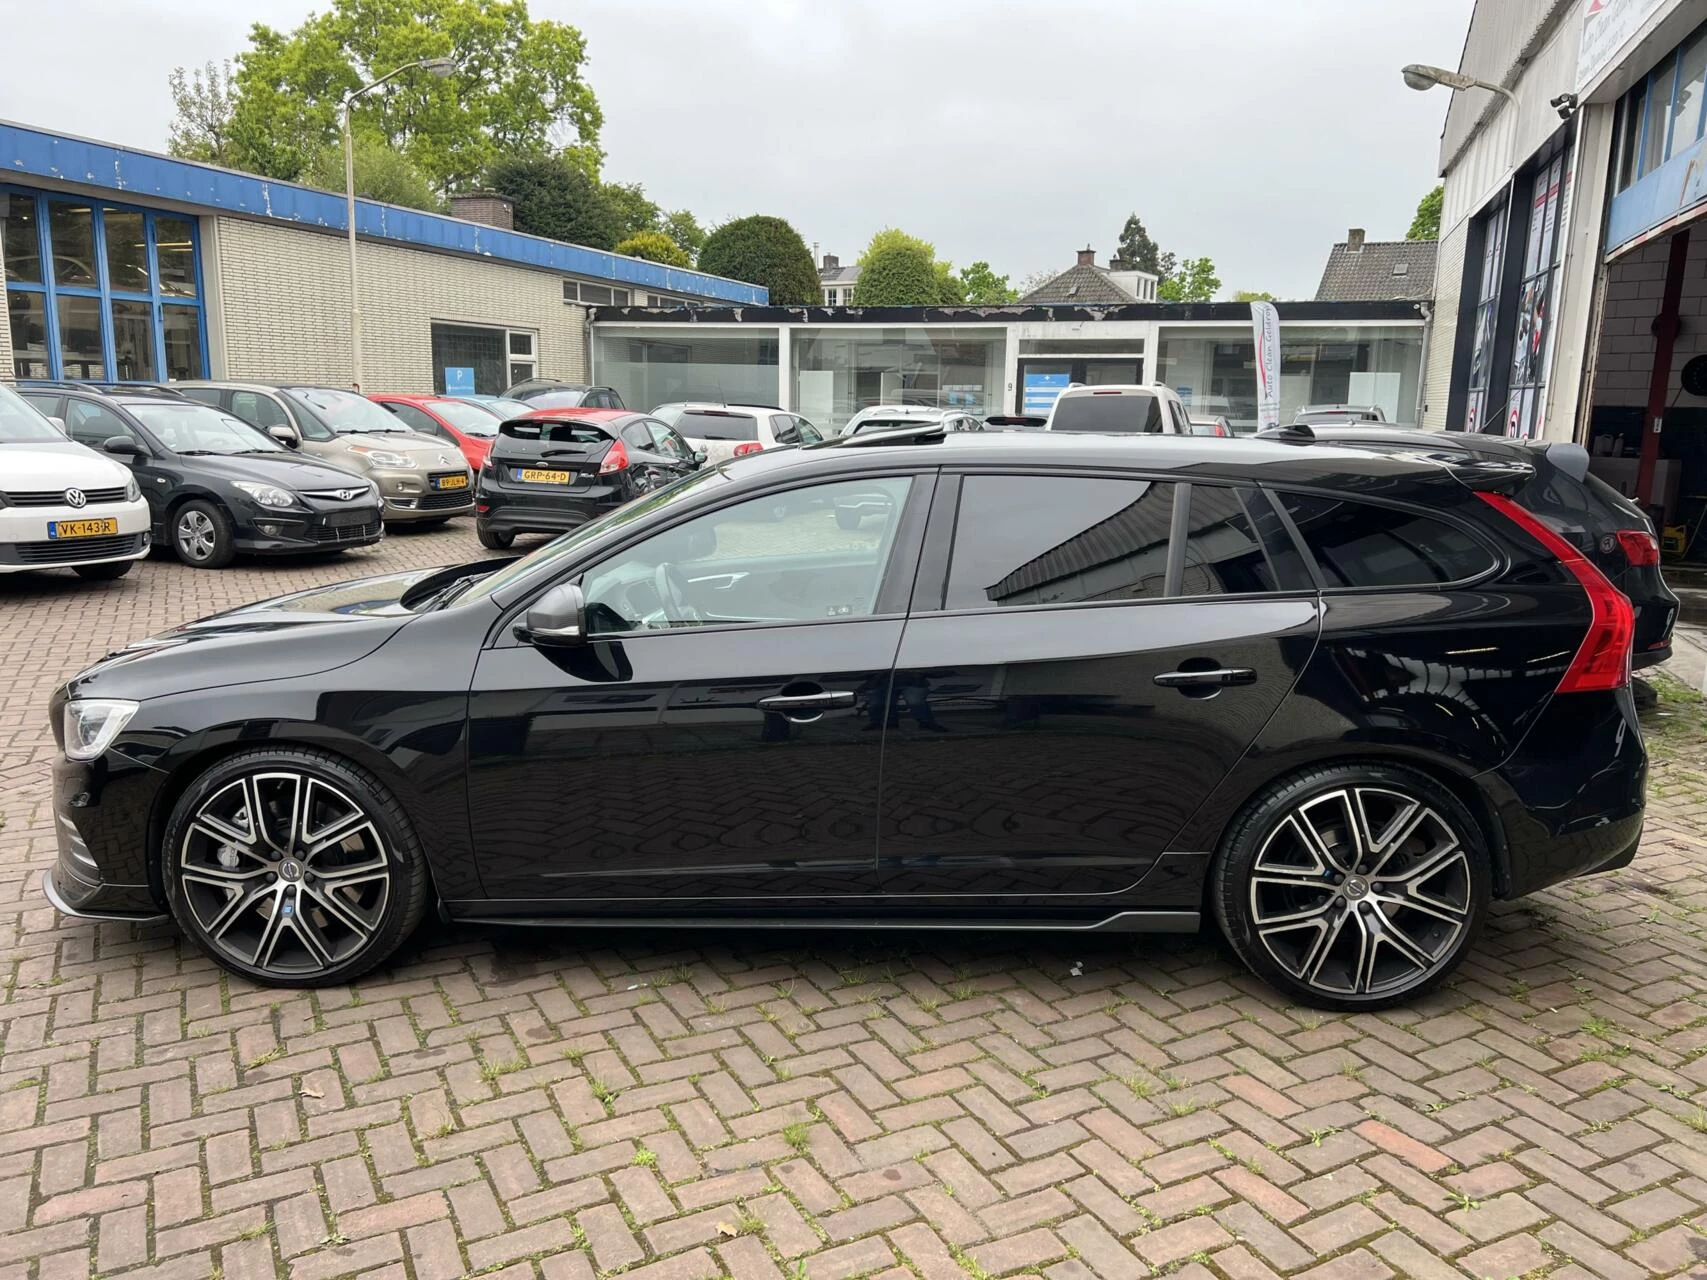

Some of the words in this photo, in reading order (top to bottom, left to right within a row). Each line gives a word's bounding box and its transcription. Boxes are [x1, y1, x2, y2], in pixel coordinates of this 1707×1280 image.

[456, 370, 463, 381] P
[1007, 383, 1013, 391] 9
[524, 470, 567, 481] GRP-64-D
[60, 521, 111, 535] VK-143-R
